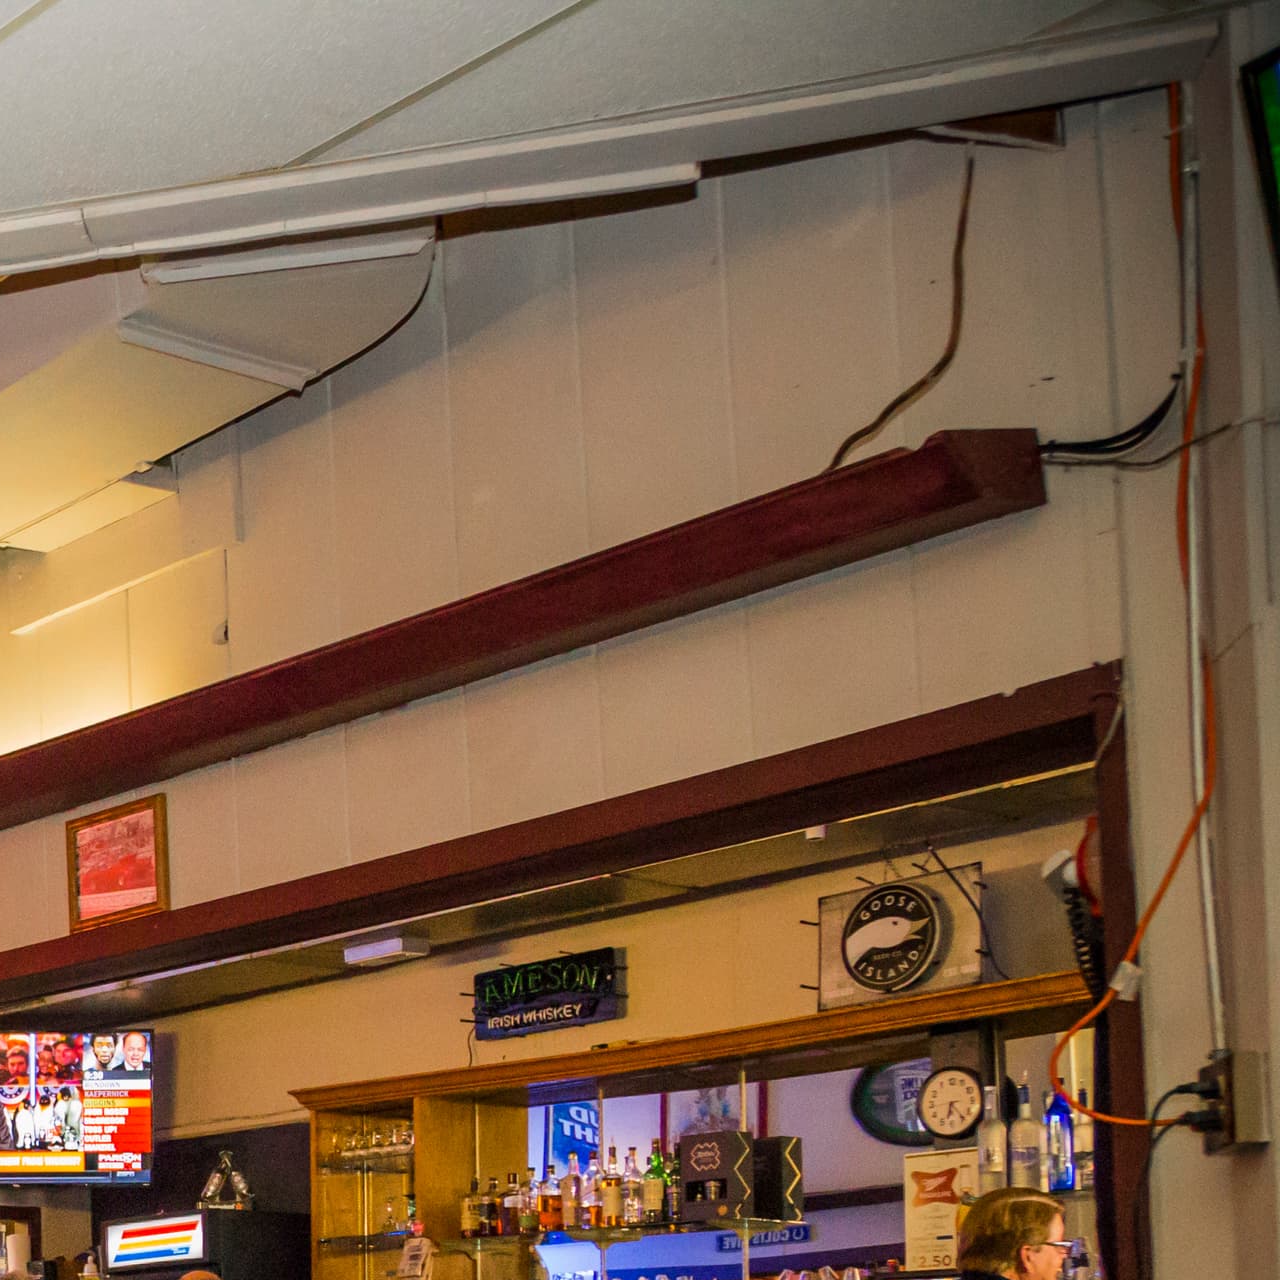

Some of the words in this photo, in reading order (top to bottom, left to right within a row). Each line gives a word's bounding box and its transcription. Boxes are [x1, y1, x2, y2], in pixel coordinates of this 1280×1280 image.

[859, 895, 918, 921] GOOSE
[858, 950, 920, 980] ISLAND
[480, 962, 601, 1005] AMESON
[487, 1013, 520, 1030] IRISH
[523, 1003, 582, 1024] WHISKEY
[918, 1255, 952, 1269] 2.50
